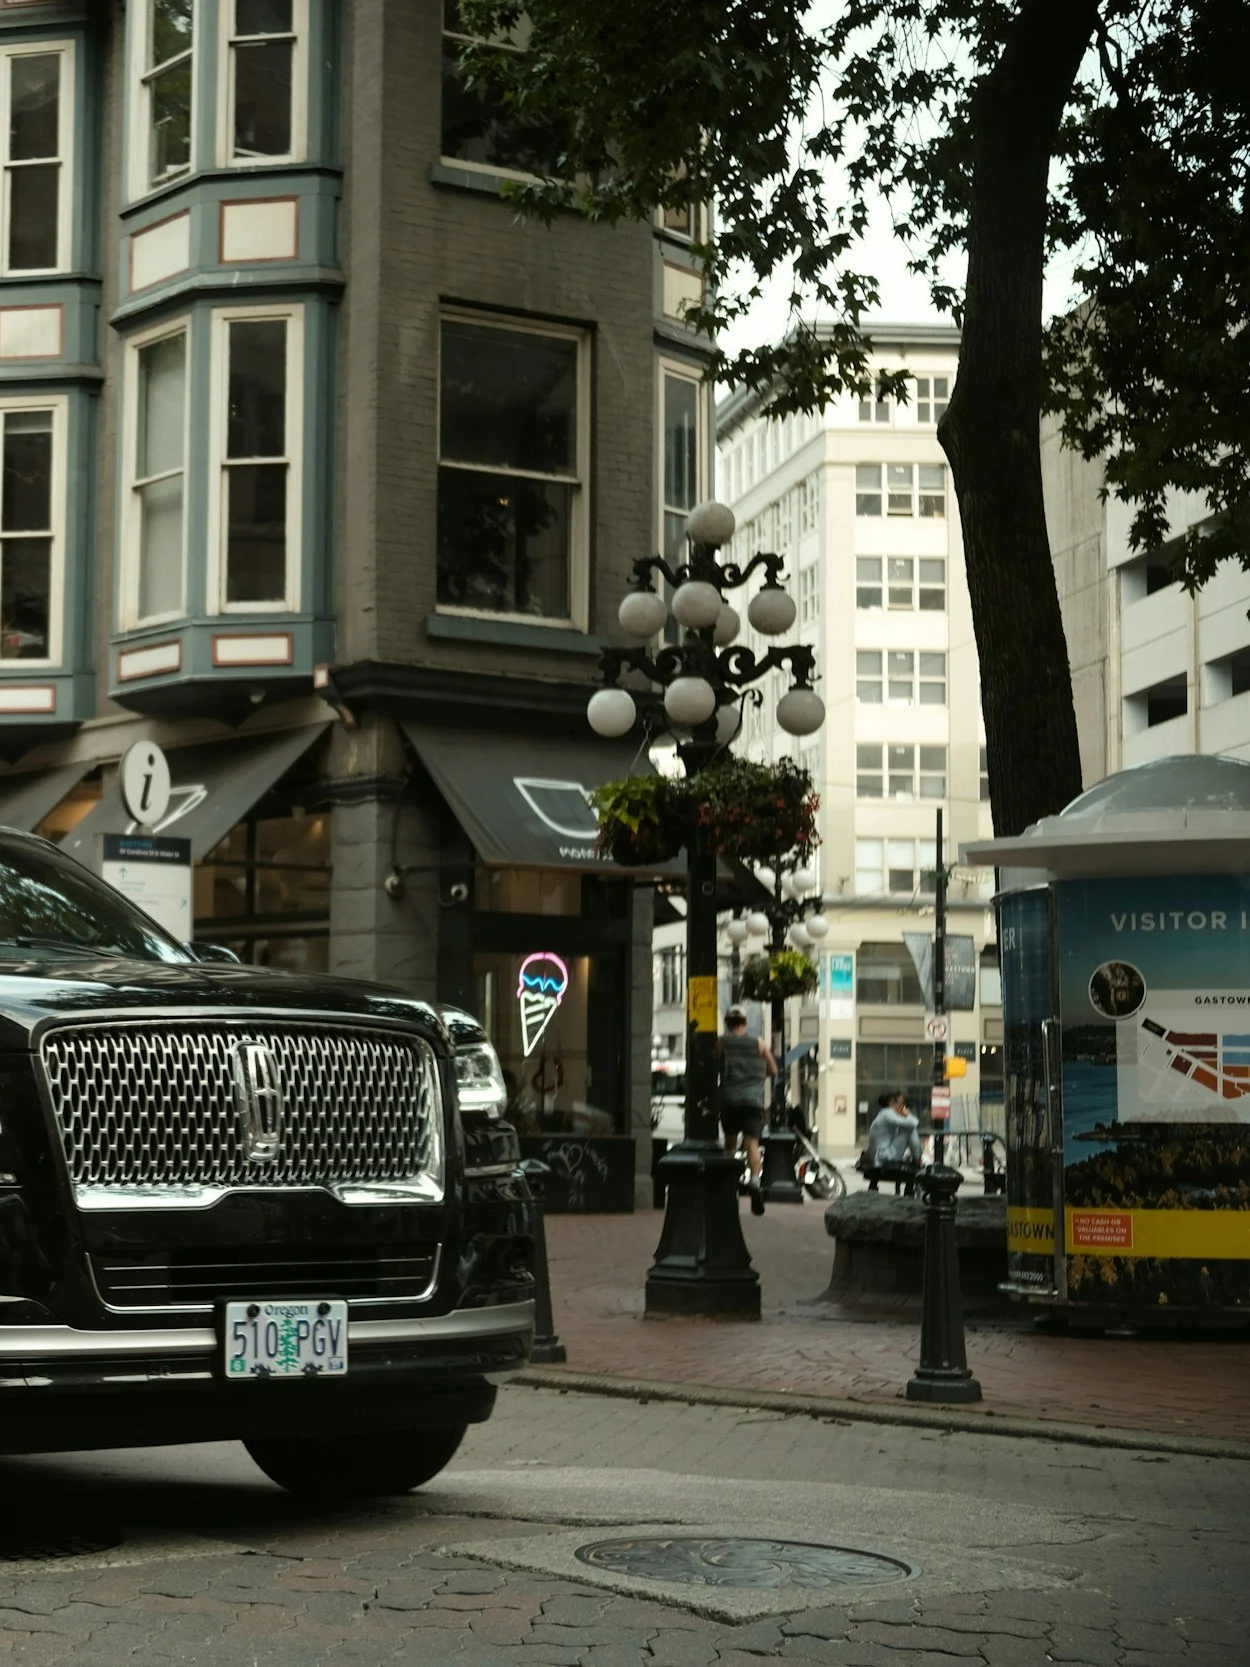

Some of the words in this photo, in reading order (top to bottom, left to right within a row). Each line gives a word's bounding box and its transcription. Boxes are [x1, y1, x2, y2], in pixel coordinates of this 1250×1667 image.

[1110, 910, 1227, 932] VISITOR
[1092, 1235, 1126, 1243] PREMISES
[264, 1304, 309, 1318] Oregon
[233, 1320, 278, 1359] 510
[297, 1318, 341, 1357] PGV
